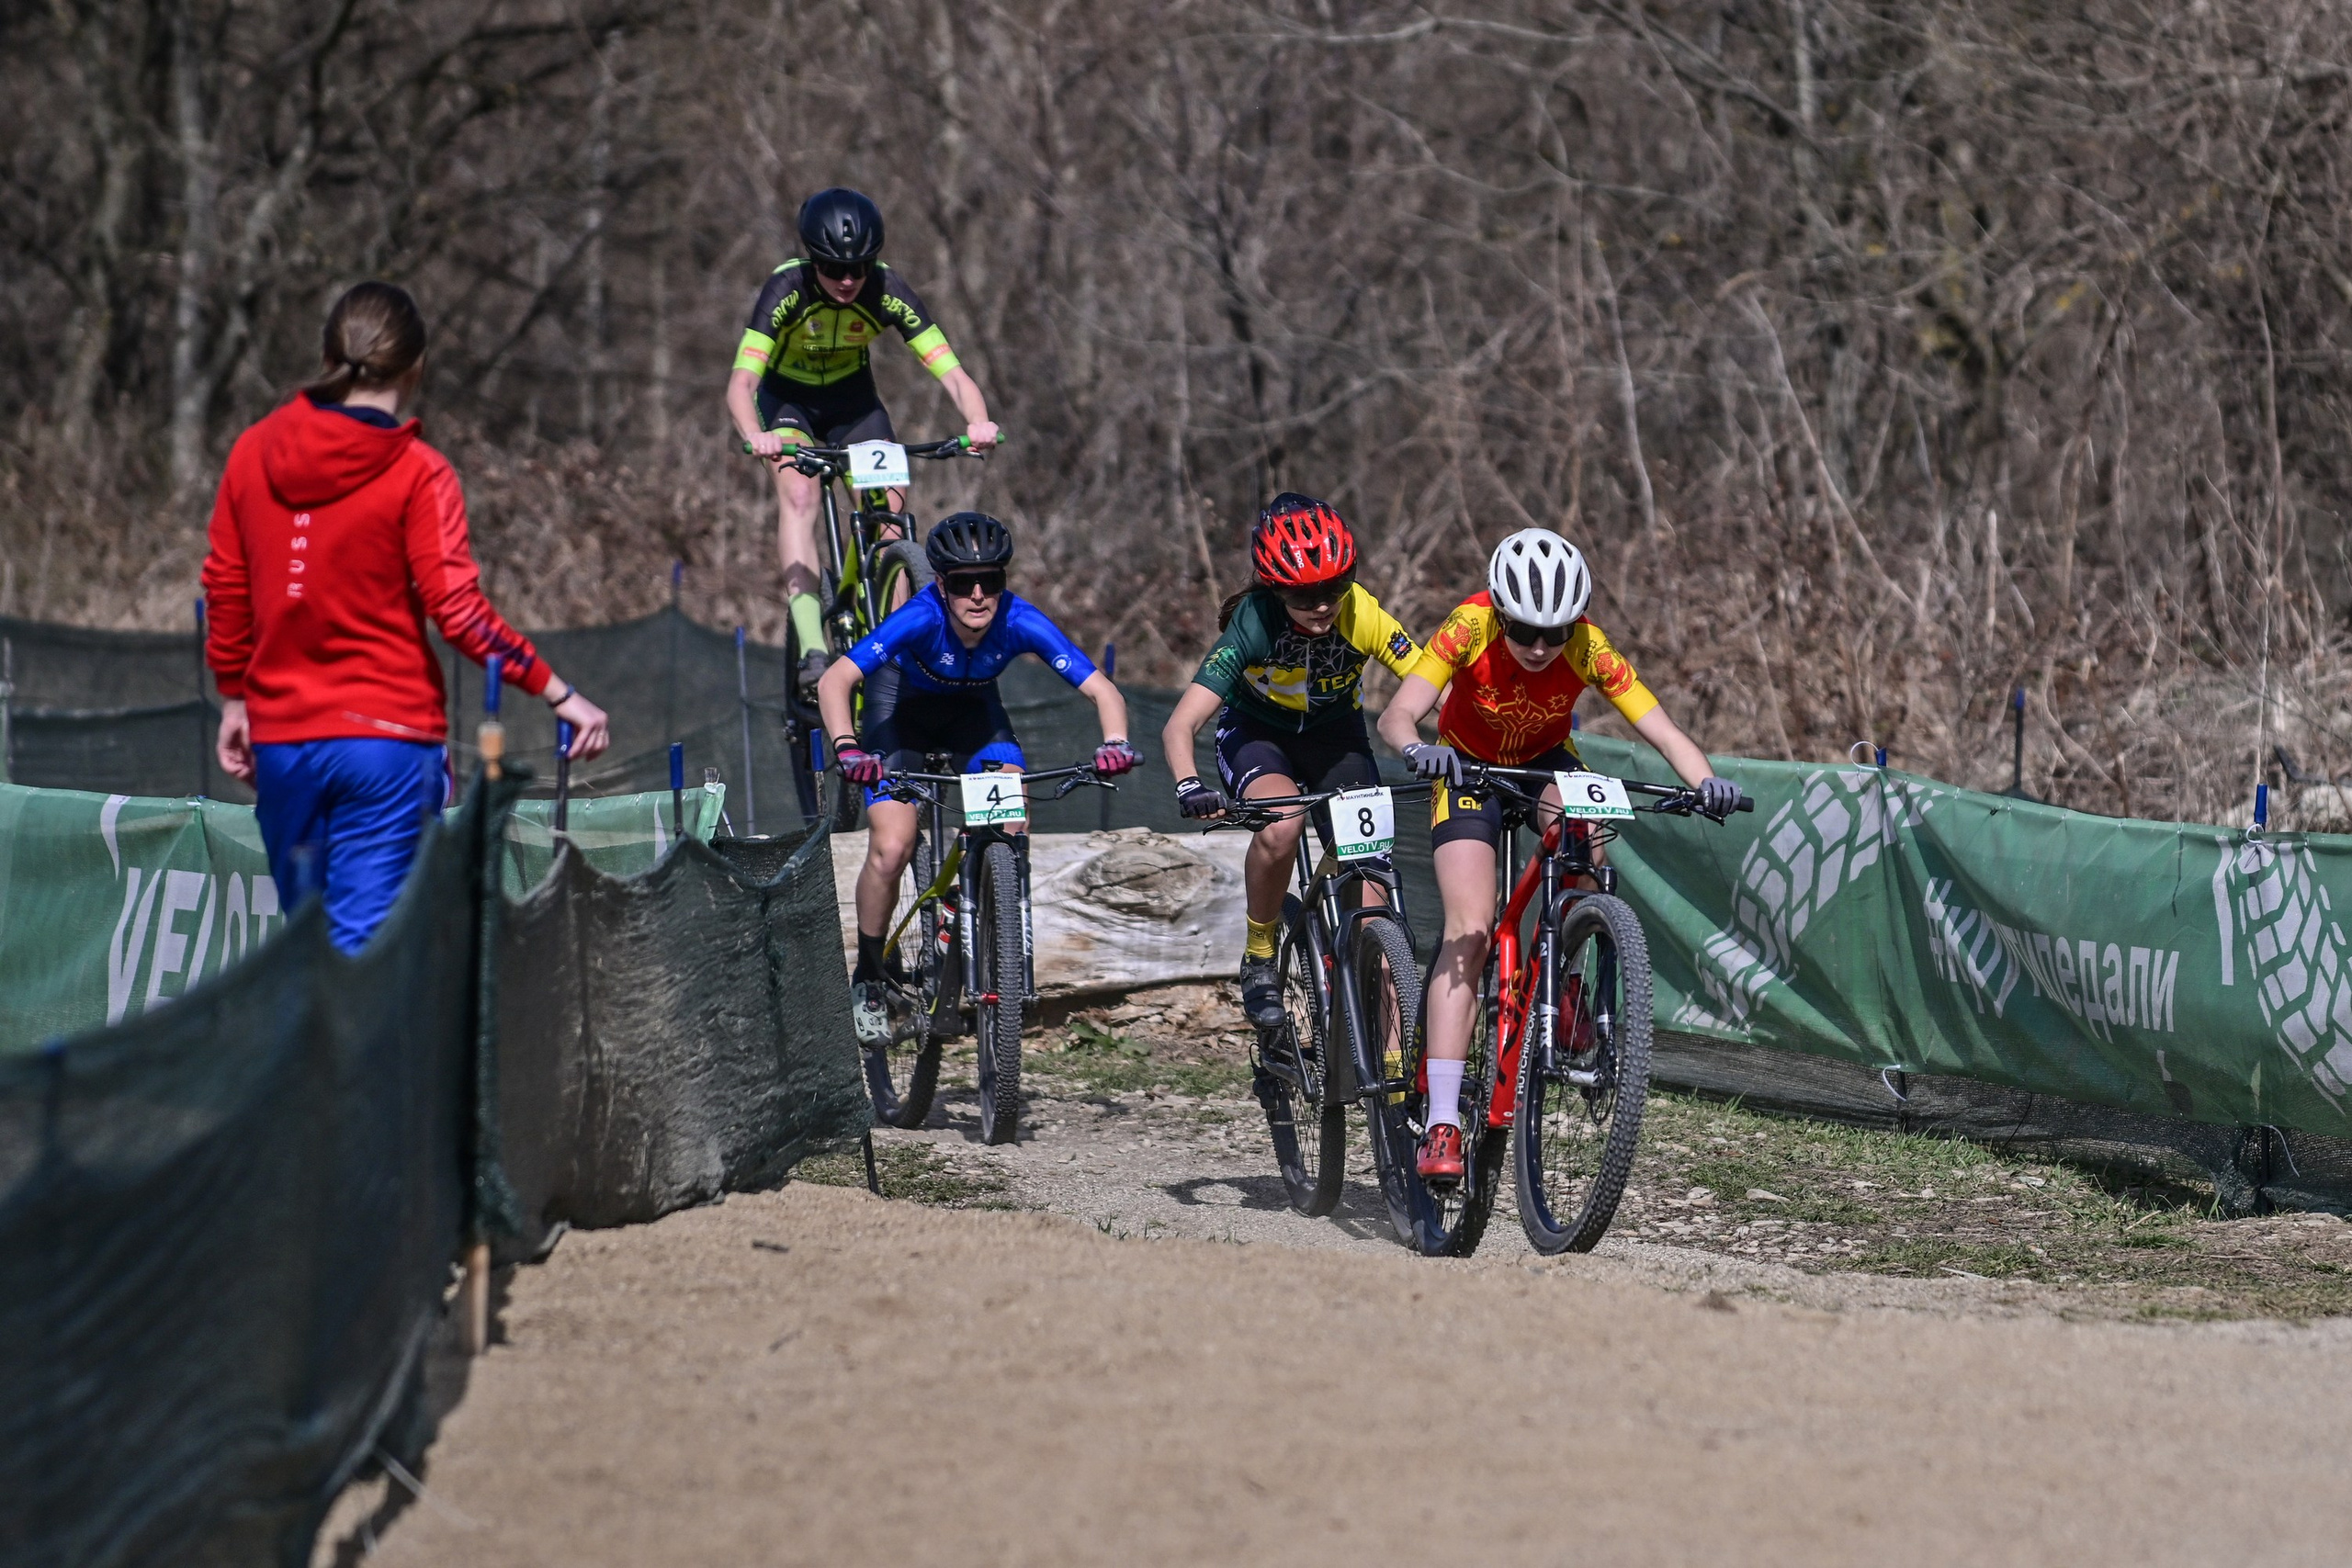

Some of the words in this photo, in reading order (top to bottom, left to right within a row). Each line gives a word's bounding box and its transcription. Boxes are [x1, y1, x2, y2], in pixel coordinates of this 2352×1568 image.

[872, 450, 888, 470] 2
[987, 784, 1002, 806] 4
[1587, 784, 1606, 804] 6
[1569, 806, 1630, 815] VELOTV.RU
[1358, 807, 1375, 838] 8
[1340, 840, 1390, 854] VELOTV.RU
[106, 867, 288, 1027] VELOT
[1518, 1011, 1537, 1094] HUTCHINSON
